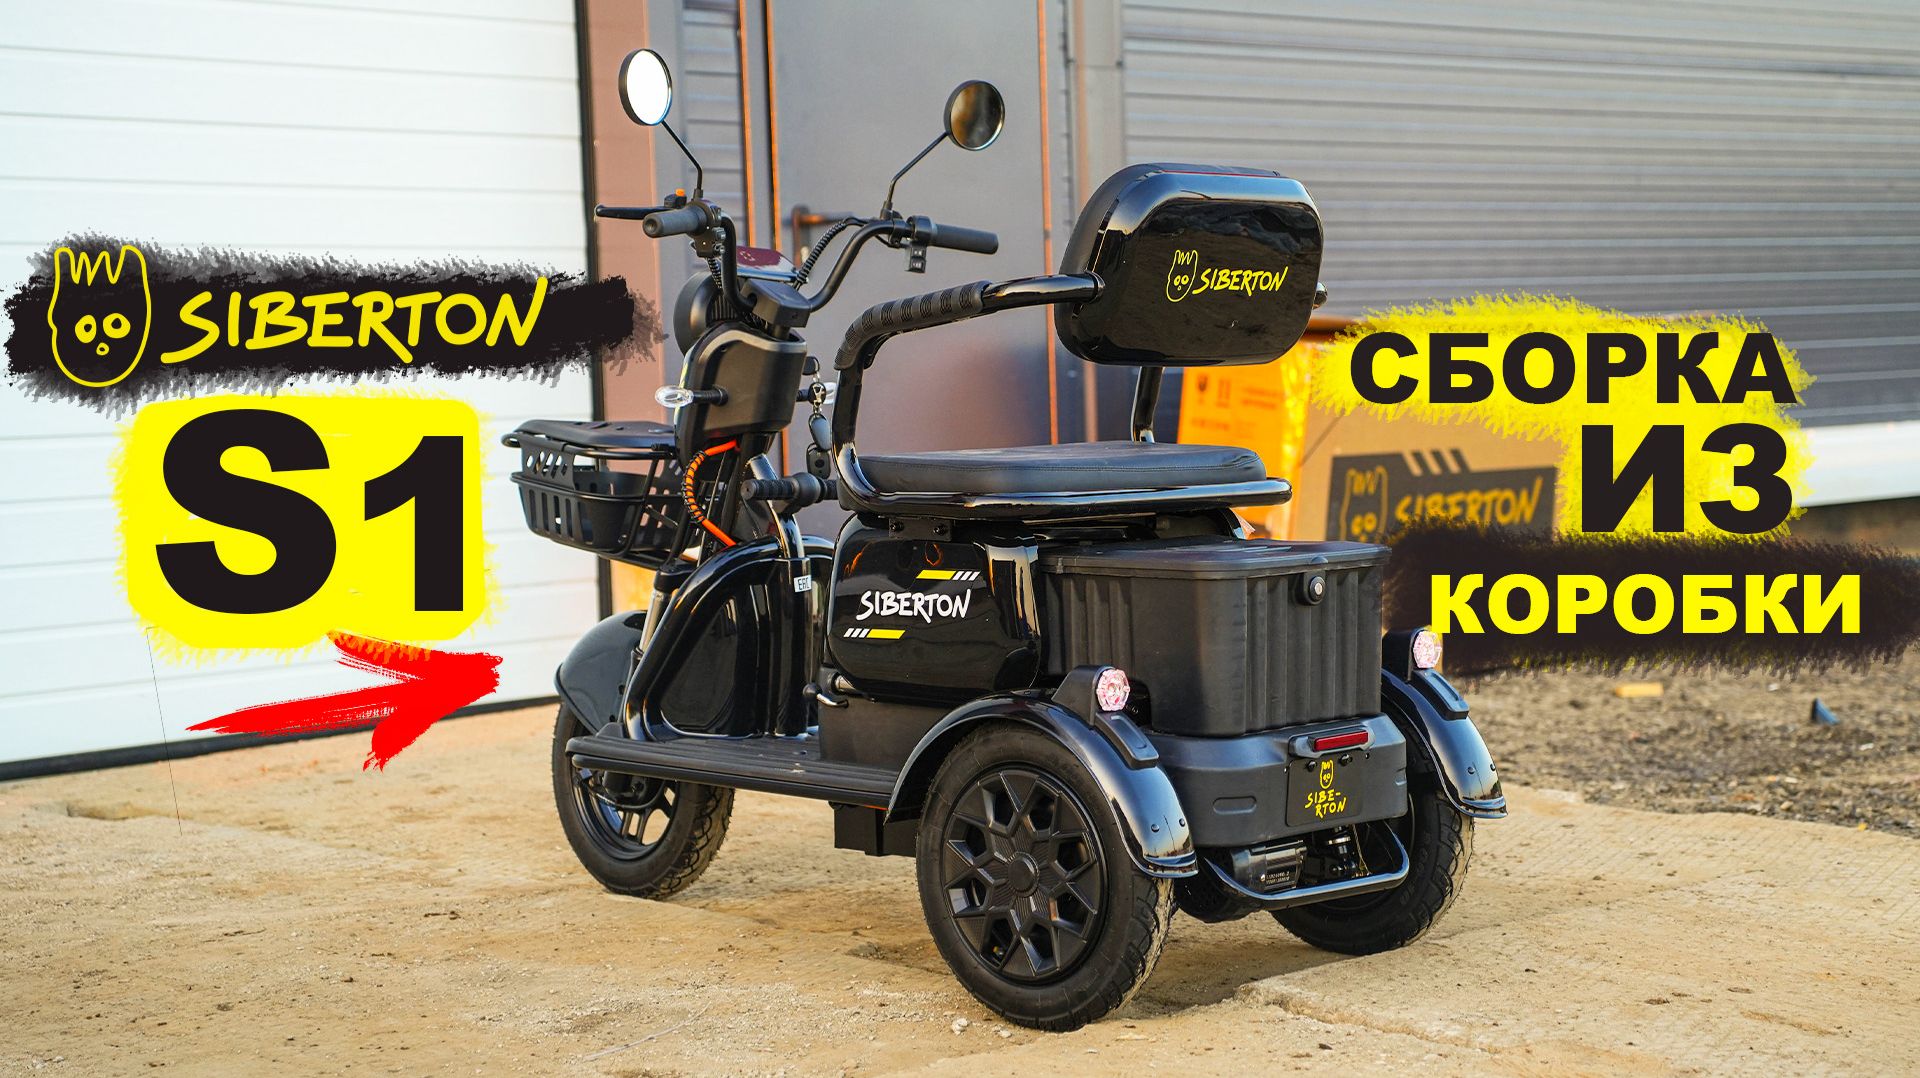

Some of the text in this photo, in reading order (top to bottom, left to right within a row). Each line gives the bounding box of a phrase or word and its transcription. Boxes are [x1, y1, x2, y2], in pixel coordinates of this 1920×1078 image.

[1192, 265, 1289, 296] SIBERTON
[856, 588, 971, 624] SIBERTON
[1315, 796, 1347, 818] RTON
